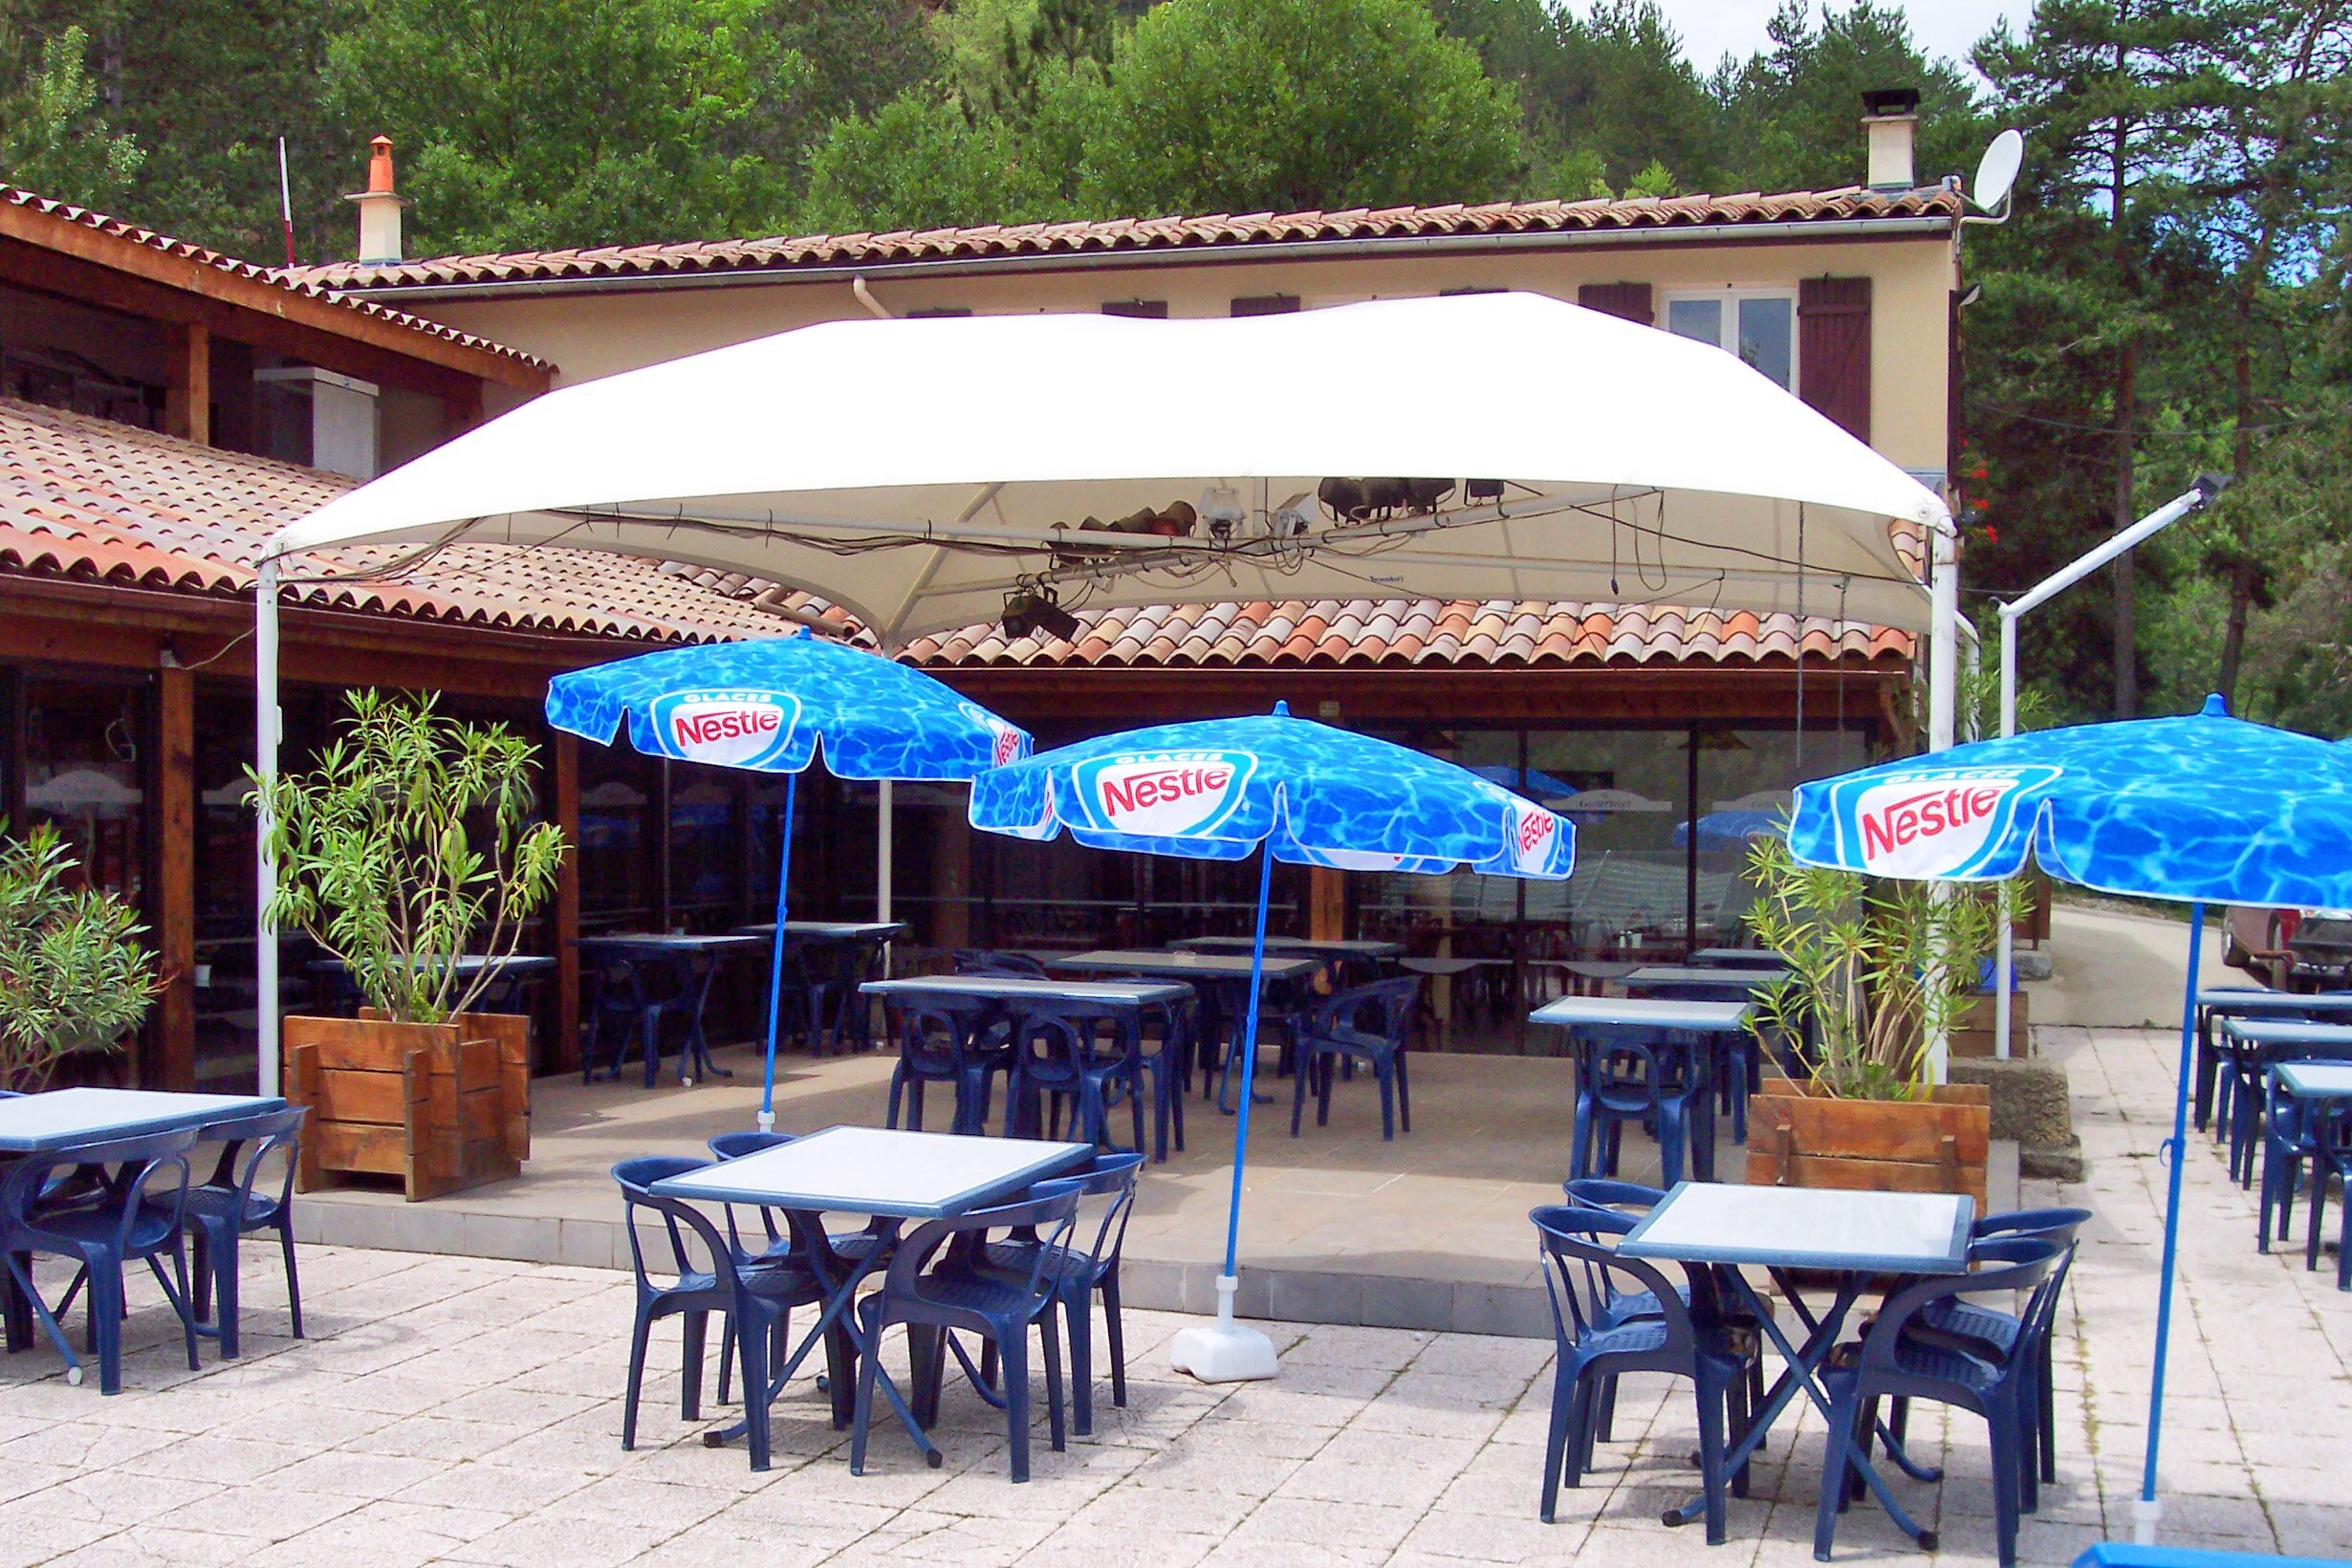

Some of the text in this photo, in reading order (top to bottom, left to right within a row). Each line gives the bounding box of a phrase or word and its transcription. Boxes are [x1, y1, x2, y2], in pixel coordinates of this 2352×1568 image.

[684, 693, 772, 703] GLACES
[1115, 752, 1224, 765] GLACES
[1884, 769, 2026, 784] GLACES
